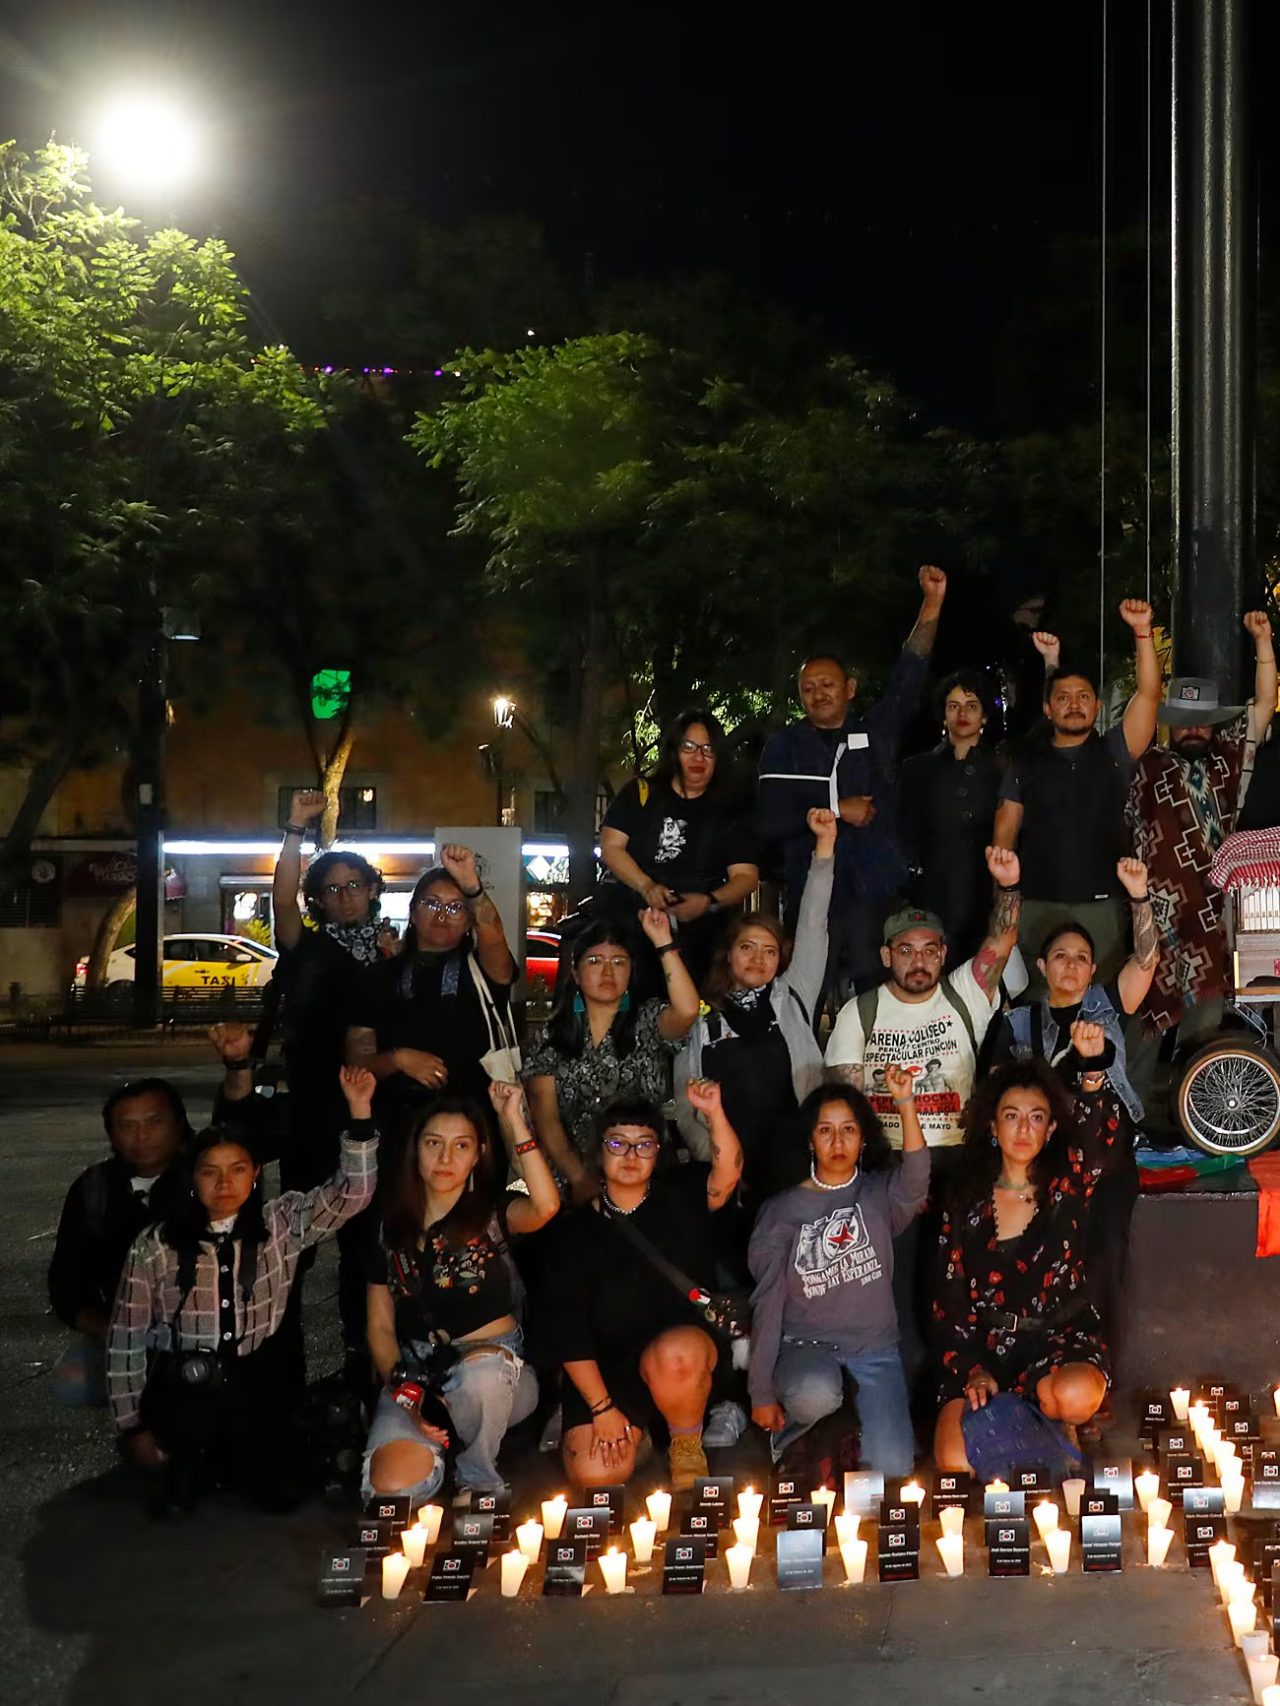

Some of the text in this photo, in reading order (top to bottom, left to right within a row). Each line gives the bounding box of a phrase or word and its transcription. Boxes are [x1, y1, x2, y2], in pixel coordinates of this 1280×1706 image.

[201, 975, 236, 987] TAXI
[870, 1032, 907, 1047] ARENA
[912, 1038, 941, 1050] CENTRO
[864, 1048, 923, 1063] SPECTACULAR
[929, 1122, 952, 1130] MAYO
